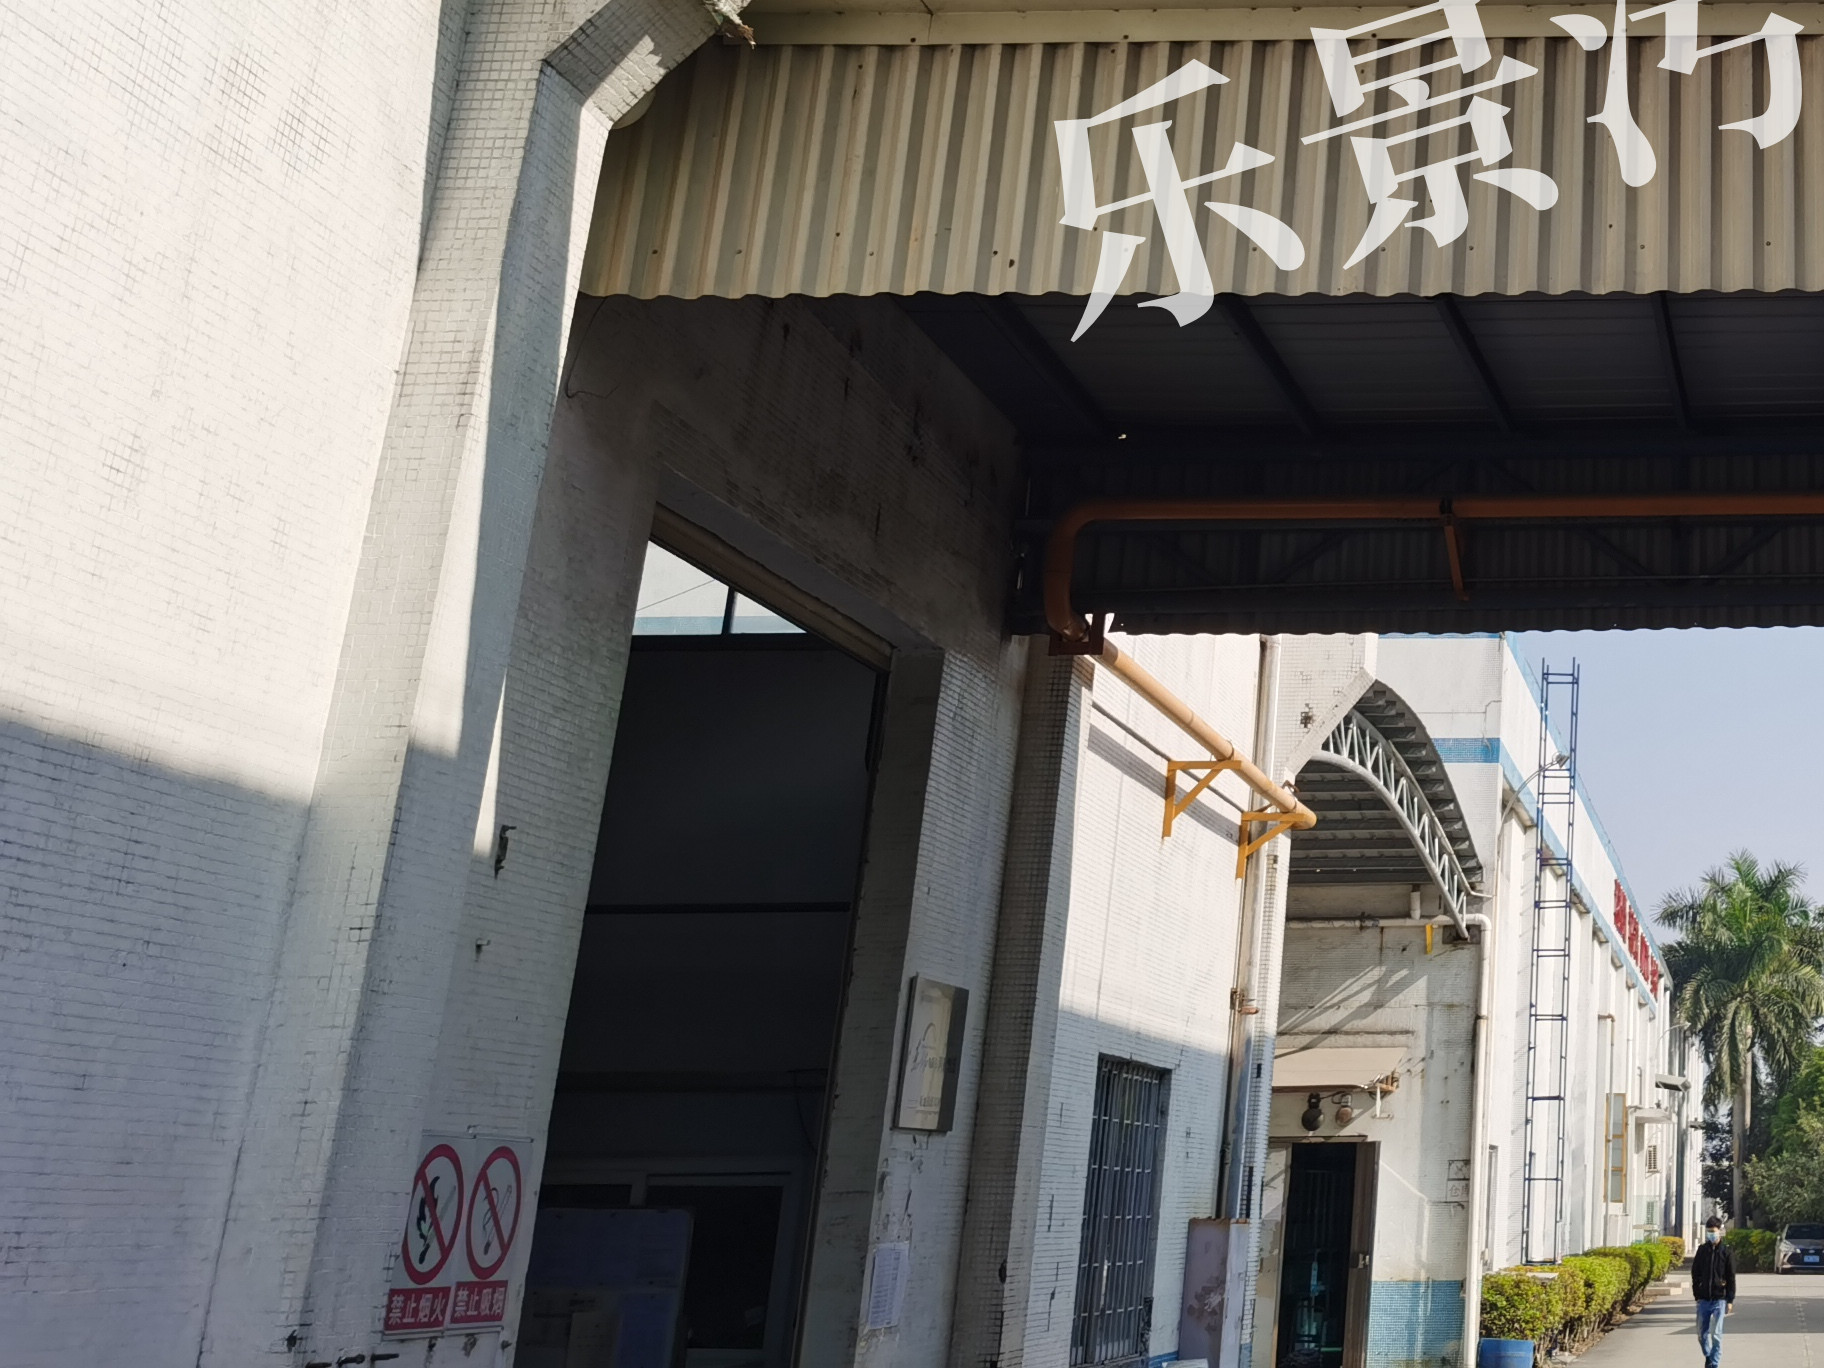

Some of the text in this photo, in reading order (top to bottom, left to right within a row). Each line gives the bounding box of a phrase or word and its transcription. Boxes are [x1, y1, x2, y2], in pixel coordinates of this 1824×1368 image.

[388, 1291, 447, 1325] 禁止烟火
[454, 1286, 506, 1319] 禁止吸烟
